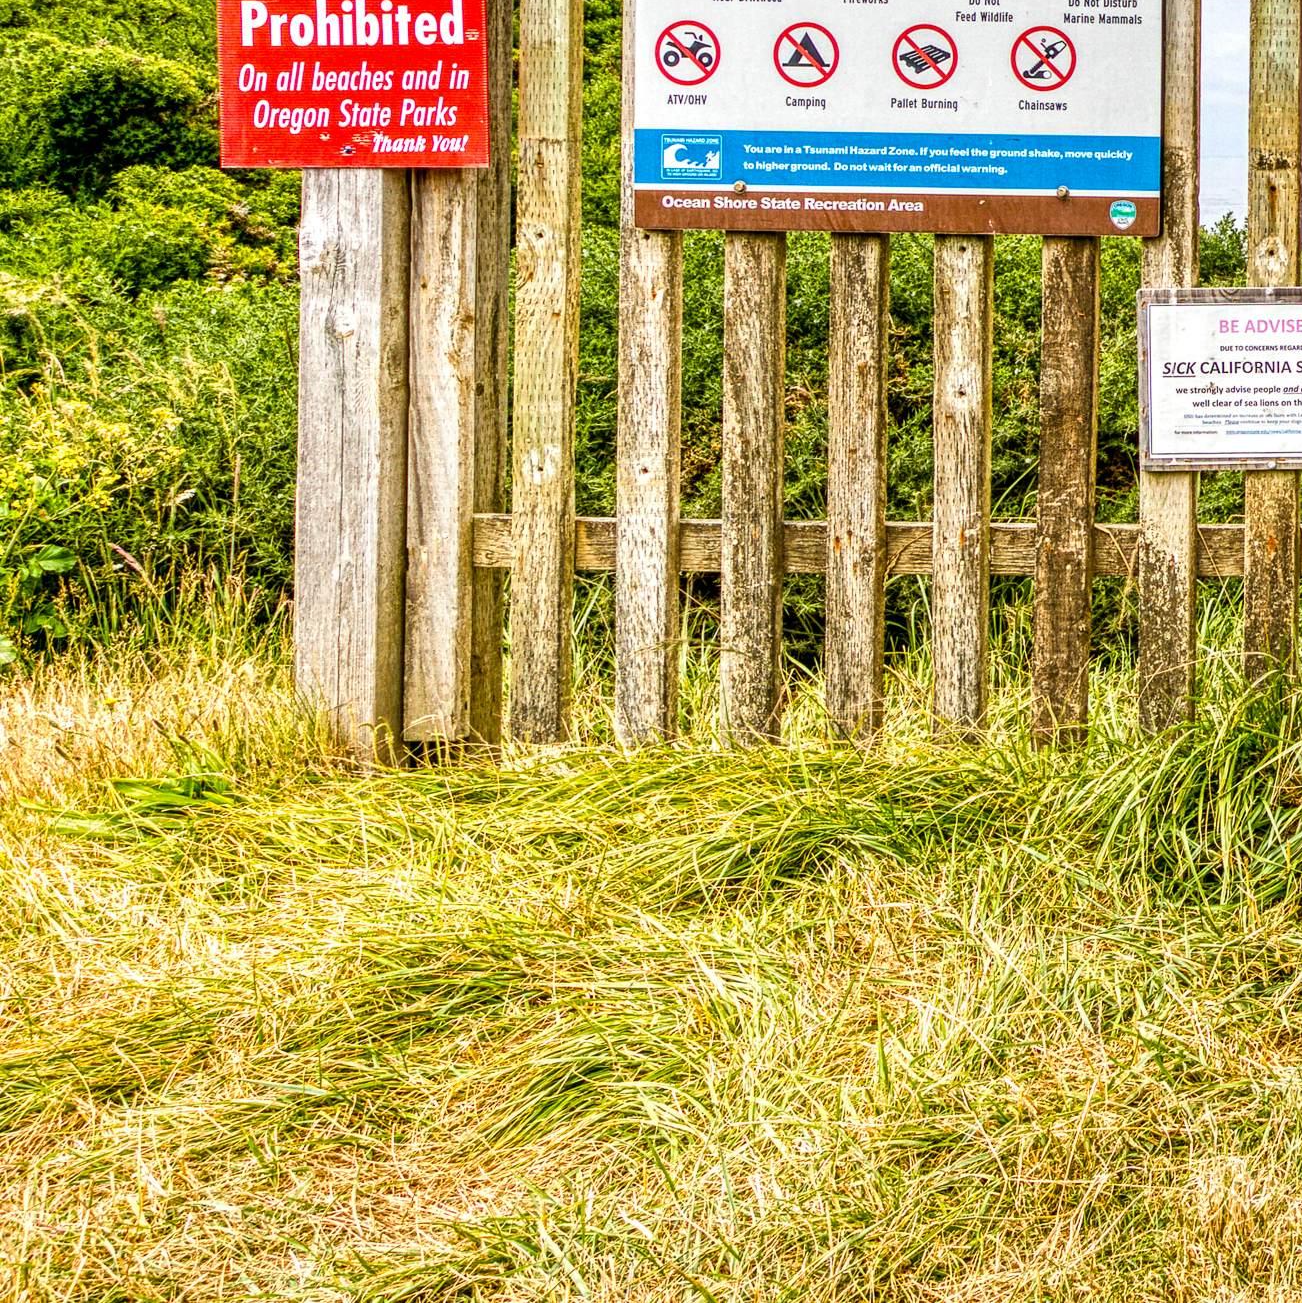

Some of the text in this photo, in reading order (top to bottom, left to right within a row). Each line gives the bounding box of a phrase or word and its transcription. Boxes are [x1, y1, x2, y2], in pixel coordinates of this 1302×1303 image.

[956, 12, 1013, 23] Feed Wildlife
[1064, 14, 1142, 25] Marine Mammals
[238, 61, 469, 91] On all beaches and in
[667, 95, 707, 105] ATV/OHV
[786, 97, 826, 110] Camping
[891, 98, 958, 112] Pallet Burning
[1019, 100, 1068, 111] Chainsaws
[253, 98, 457, 134] Oregon State Parks
[373, 134, 469, 153] Thank You!
[744, 145, 763, 153] You
[784, 146, 794, 154] in
[803, 146, 848, 155] Tsunami
[849, 146, 887, 155] Hazard
[888, 148, 918, 156] Zone.
[920, 147, 928, 156] If
[929, 149, 948, 158] you
[950, 147, 969, 157] feel
[971, 148, 988, 157] the
[990, 149, 1027, 159] ground
[1029, 149, 1063, 159] shake,
[1095, 150, 1133, 160] quickly
[743, 162, 754, 170] to
[756, 162, 790, 172] higher
[791, 162, 830, 172] ground.
[834, 163, 848, 171] Do
[893, 164, 909, 172] for
[924, 164, 960, 173] official
[962, 165, 1008, 175] warning.
[662, 195, 924, 212] Ocean Shore State Recreation Area
[1219, 320, 1239, 333] BE
[1163, 362, 1196, 377] SICK
[1200, 361, 1292, 375] CALIFORNIA
[1190, 385, 1224, 395] strongly
[1226, 386, 1251, 394] advise
[1253, 386, 1281, 396] people
[1284, 385, 1299, 393] and
[1212, 399, 1233, 407] clear
[1235, 399, 1243, 407] of
[1260, 399, 1279, 407] lions
